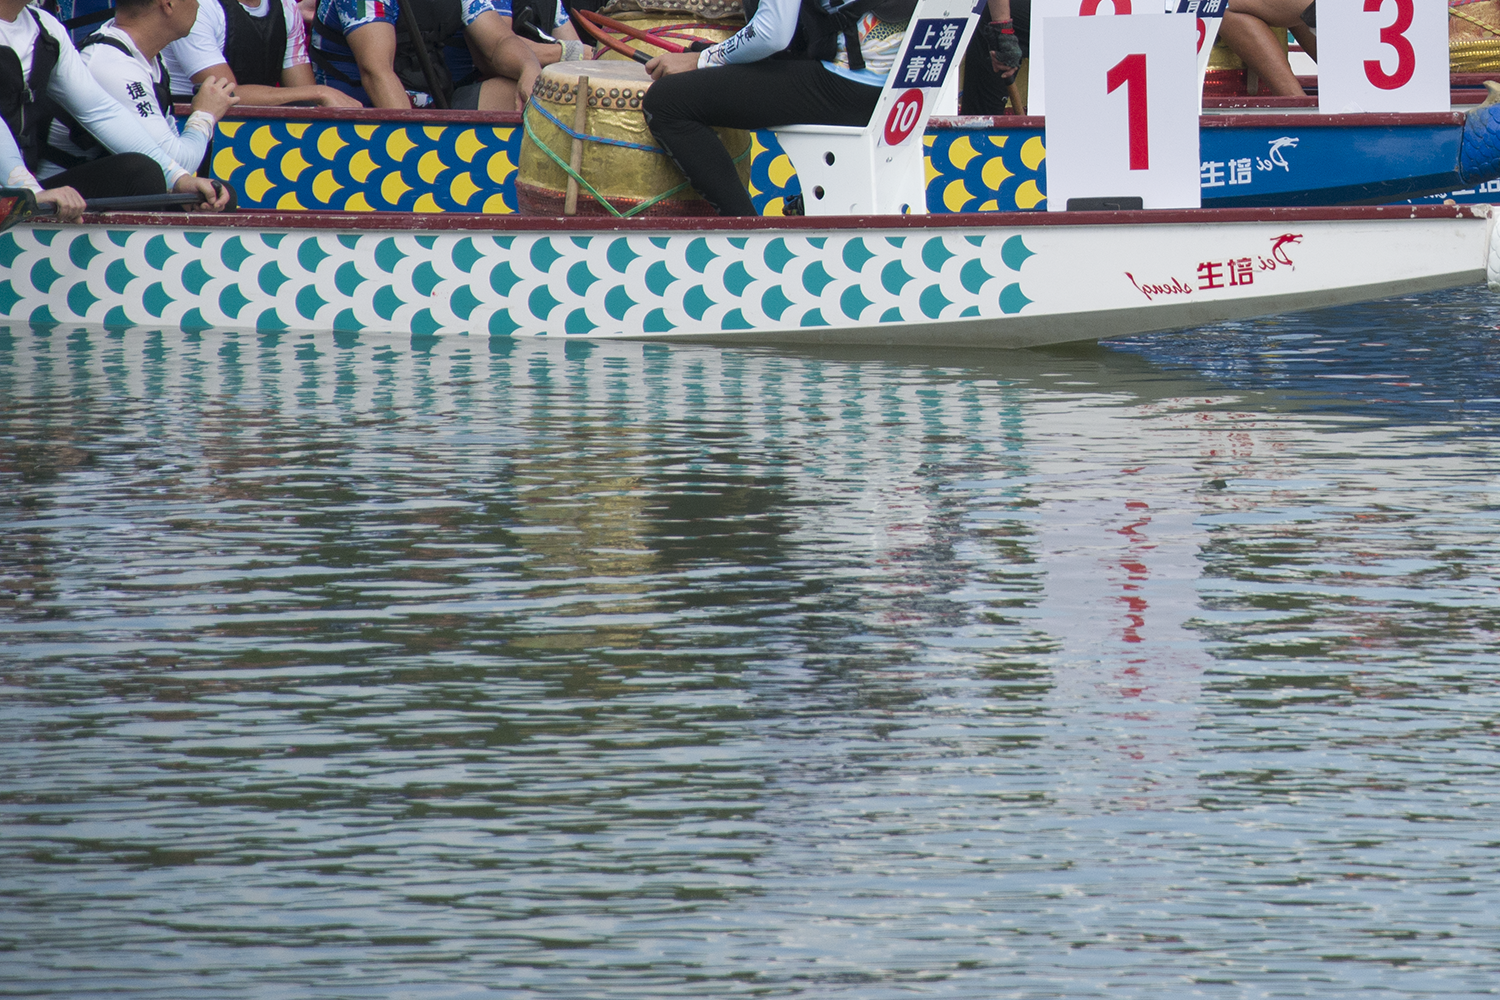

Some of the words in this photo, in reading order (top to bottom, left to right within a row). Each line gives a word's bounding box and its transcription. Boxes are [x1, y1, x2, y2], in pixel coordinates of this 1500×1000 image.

[914, 23, 959, 50] 上海
[904, 55, 947, 83] 青浦
[890, 100, 918, 133] 10
[1106, 53, 1149, 170] 1
